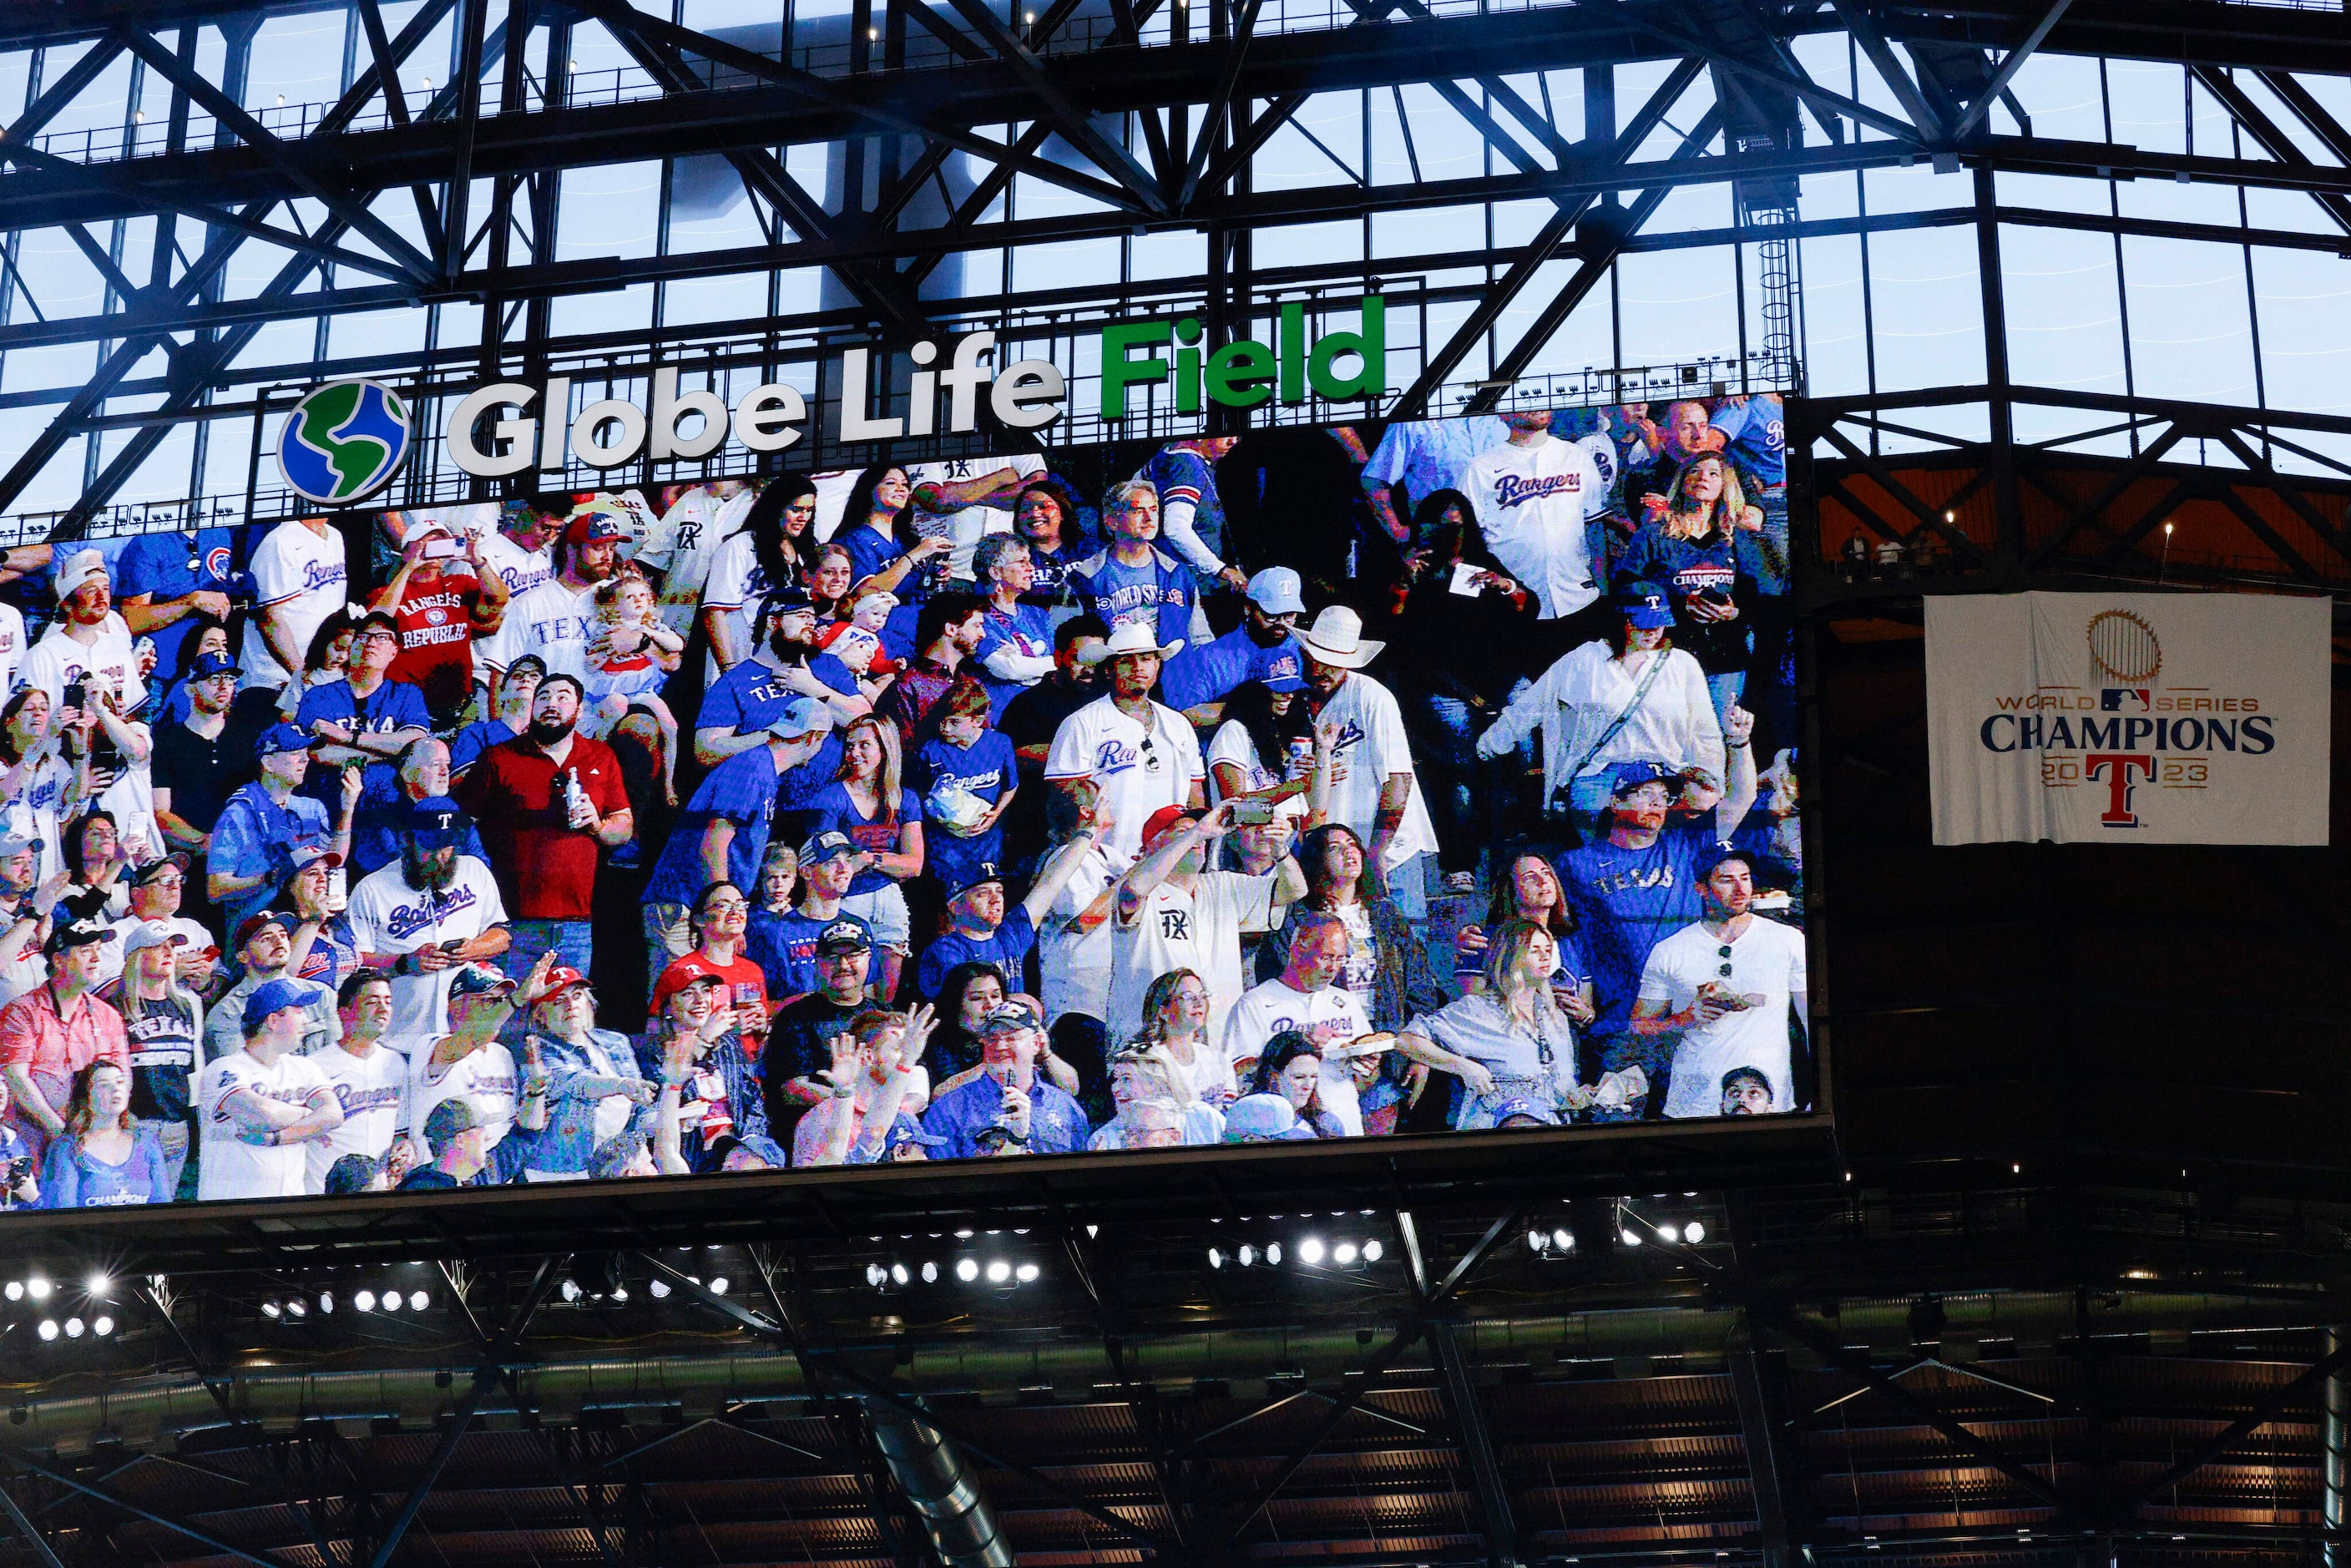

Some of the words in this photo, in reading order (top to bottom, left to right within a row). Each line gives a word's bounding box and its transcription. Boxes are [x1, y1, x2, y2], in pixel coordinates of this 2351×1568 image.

[447, 366, 807, 478] Globe
[839, 331, 1067, 443] Life
[1100, 295, 1386, 419] Field
[1278, 579, 1292, 596] T
[1645, 595, 1661, 609] T
[402, 622, 468, 649] REPUBLIC
[213, 650, 229, 665] T
[1995, 694, 2096, 711] WORLD
[2155, 697, 2260, 712] SERIES
[1979, 713, 2277, 756] CHAMPIONS
[2162, 763, 2209, 781] 23
[438, 812, 453, 830] T
[1716, 840, 1734, 852] T
[980, 862, 996, 877] T
[554, 967, 569, 979] T
[685, 964, 700, 975] T
